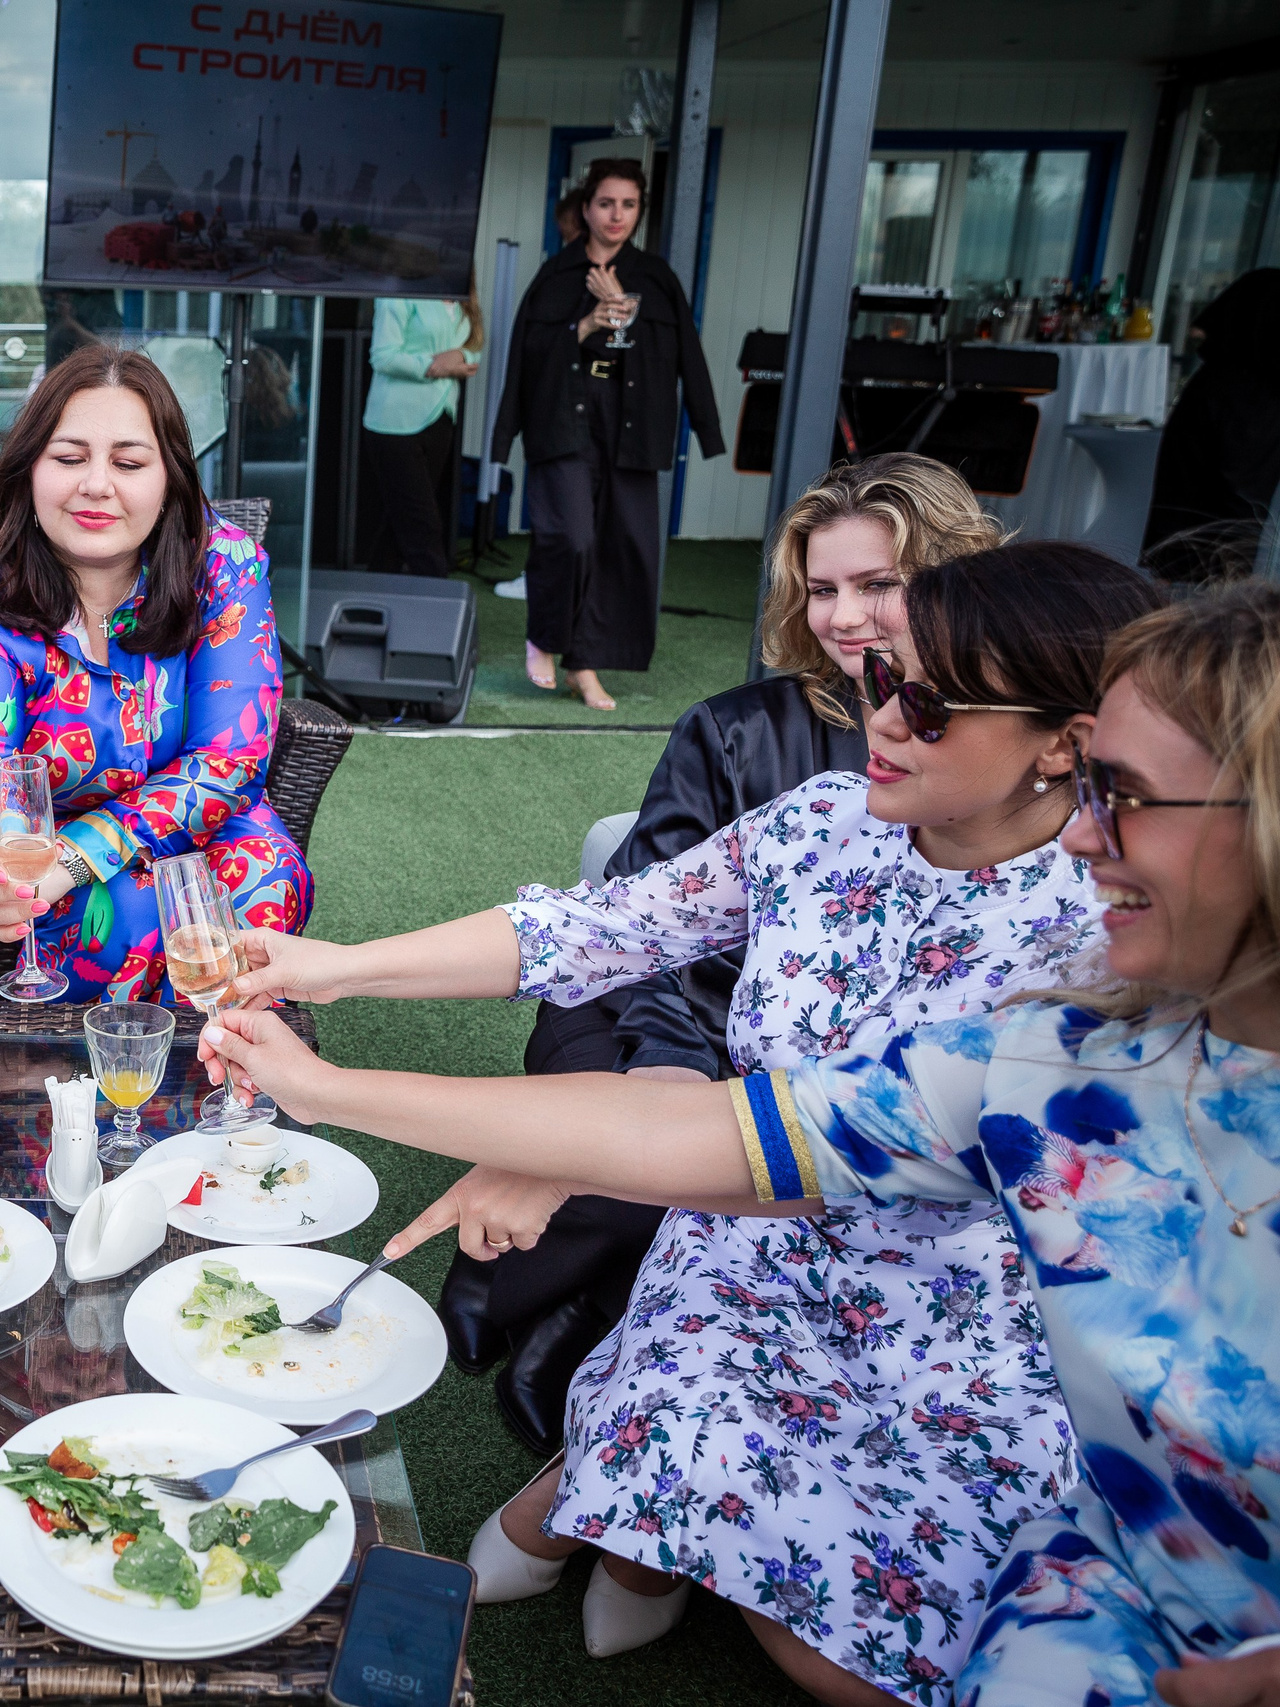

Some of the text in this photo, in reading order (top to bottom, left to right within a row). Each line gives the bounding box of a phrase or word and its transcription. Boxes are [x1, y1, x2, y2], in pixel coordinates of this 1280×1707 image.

[190, 4, 383, 48] С ДНЁМ
[132, 42, 427, 94] СТРОИТЕЛЯ
[361, 1665, 424, 1695] 16:58
